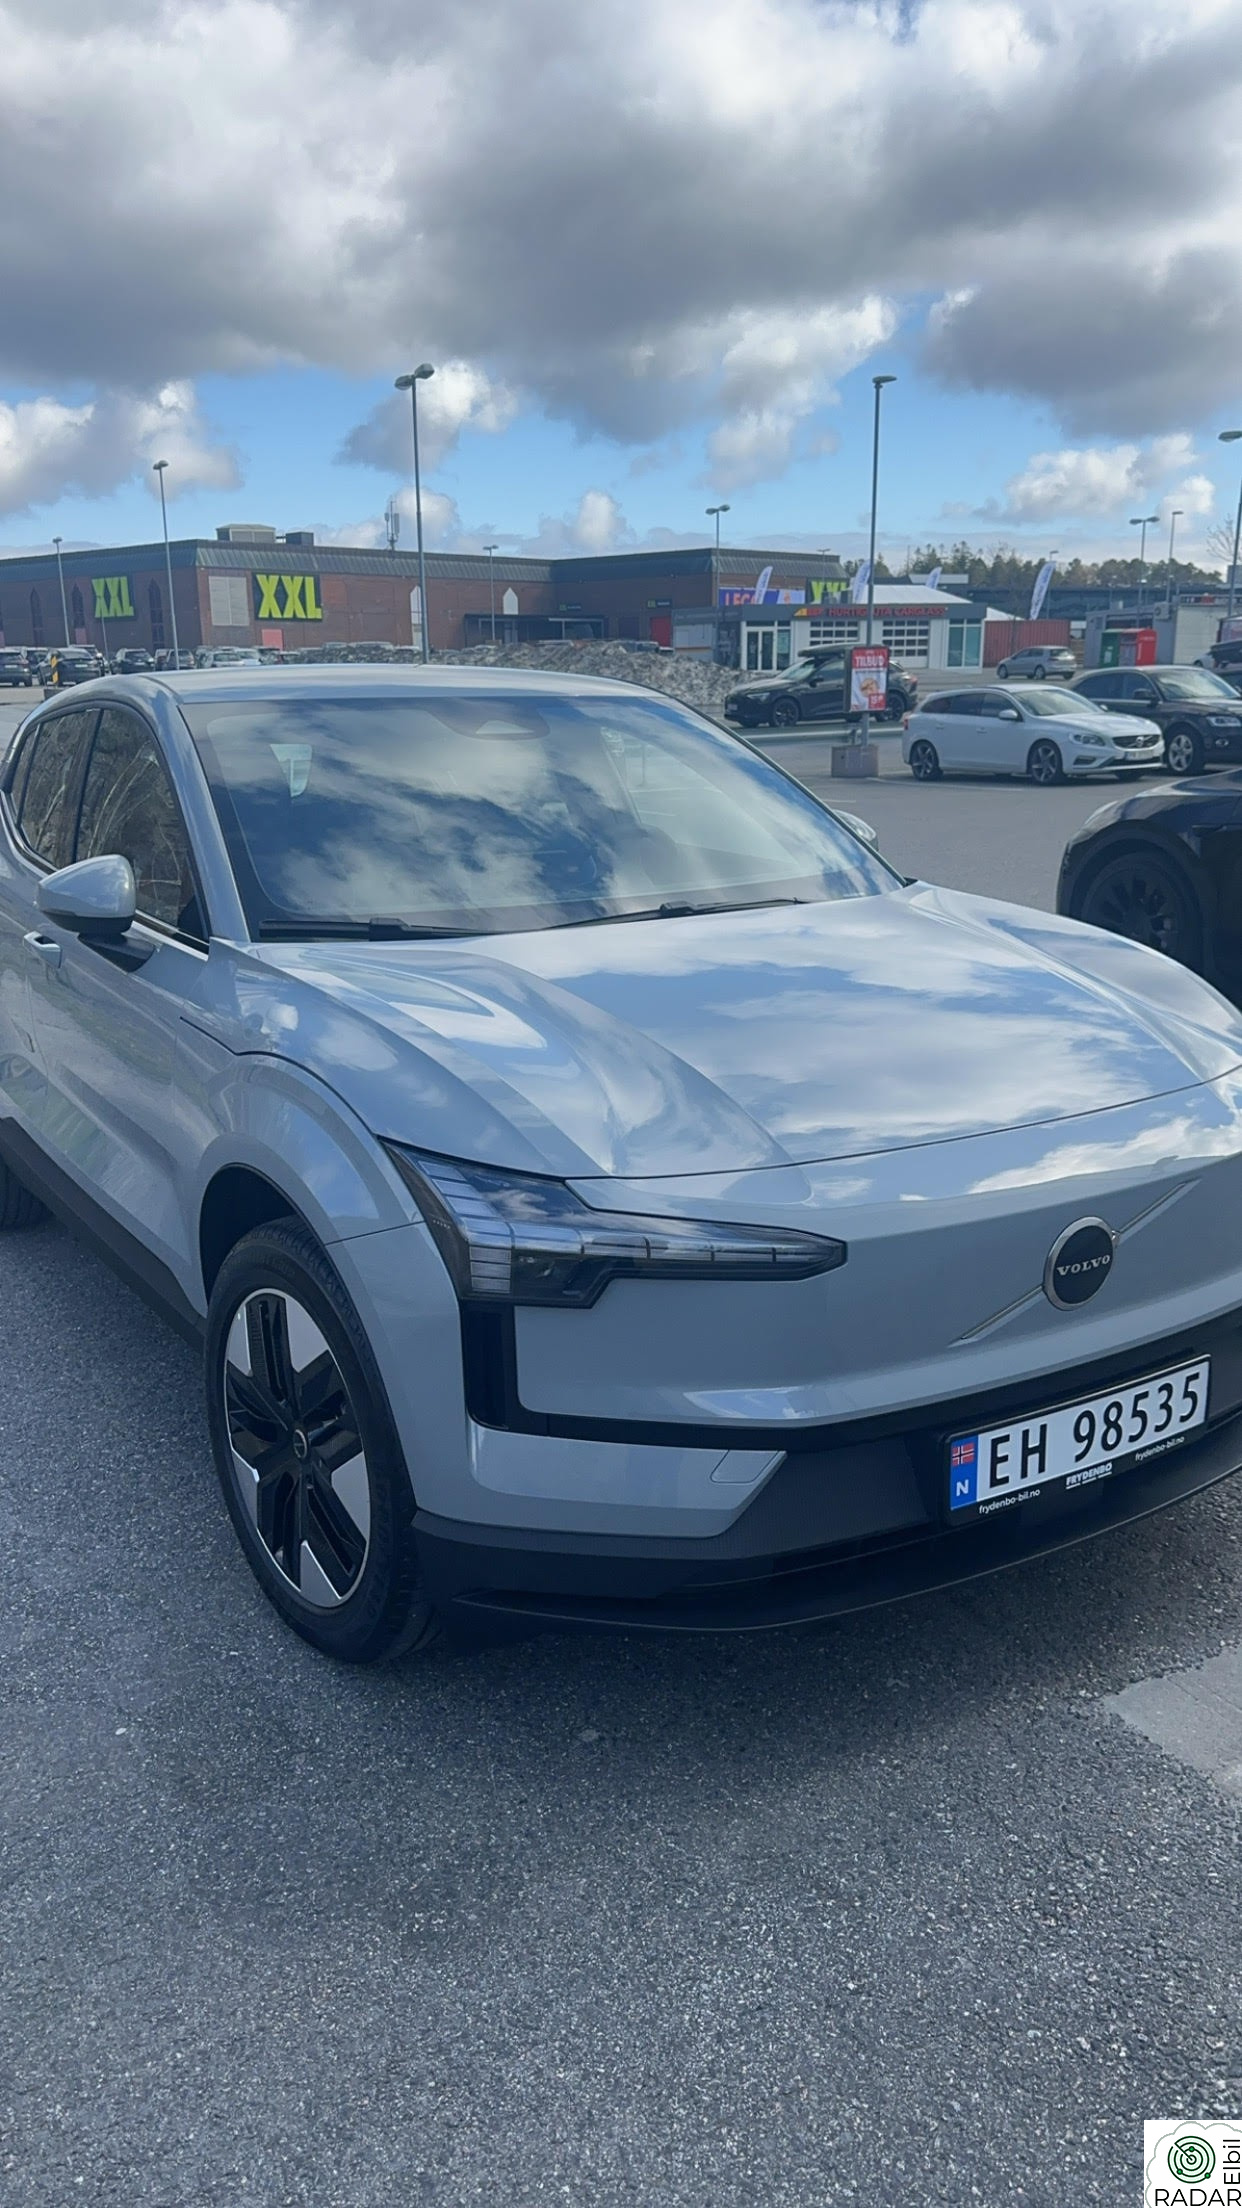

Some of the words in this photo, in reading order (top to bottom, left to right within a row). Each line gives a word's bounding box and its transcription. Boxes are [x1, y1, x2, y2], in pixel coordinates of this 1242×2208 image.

[91, 576, 134, 618] XXL
[256, 574, 322, 619] XXL
[855, 655, 885, 667] TILBUD
[1056, 1254, 1111, 1276] VOLVO
[989, 1423, 1048, 1489] EH
[1073, 1372, 1200, 1463] 98535
[1135, 1436, 1185, 1461] frydenbo-bil.no
[956, 1478, 969, 1497] N
[978, 1489, 1041, 1514] frydenbo-bil.no
